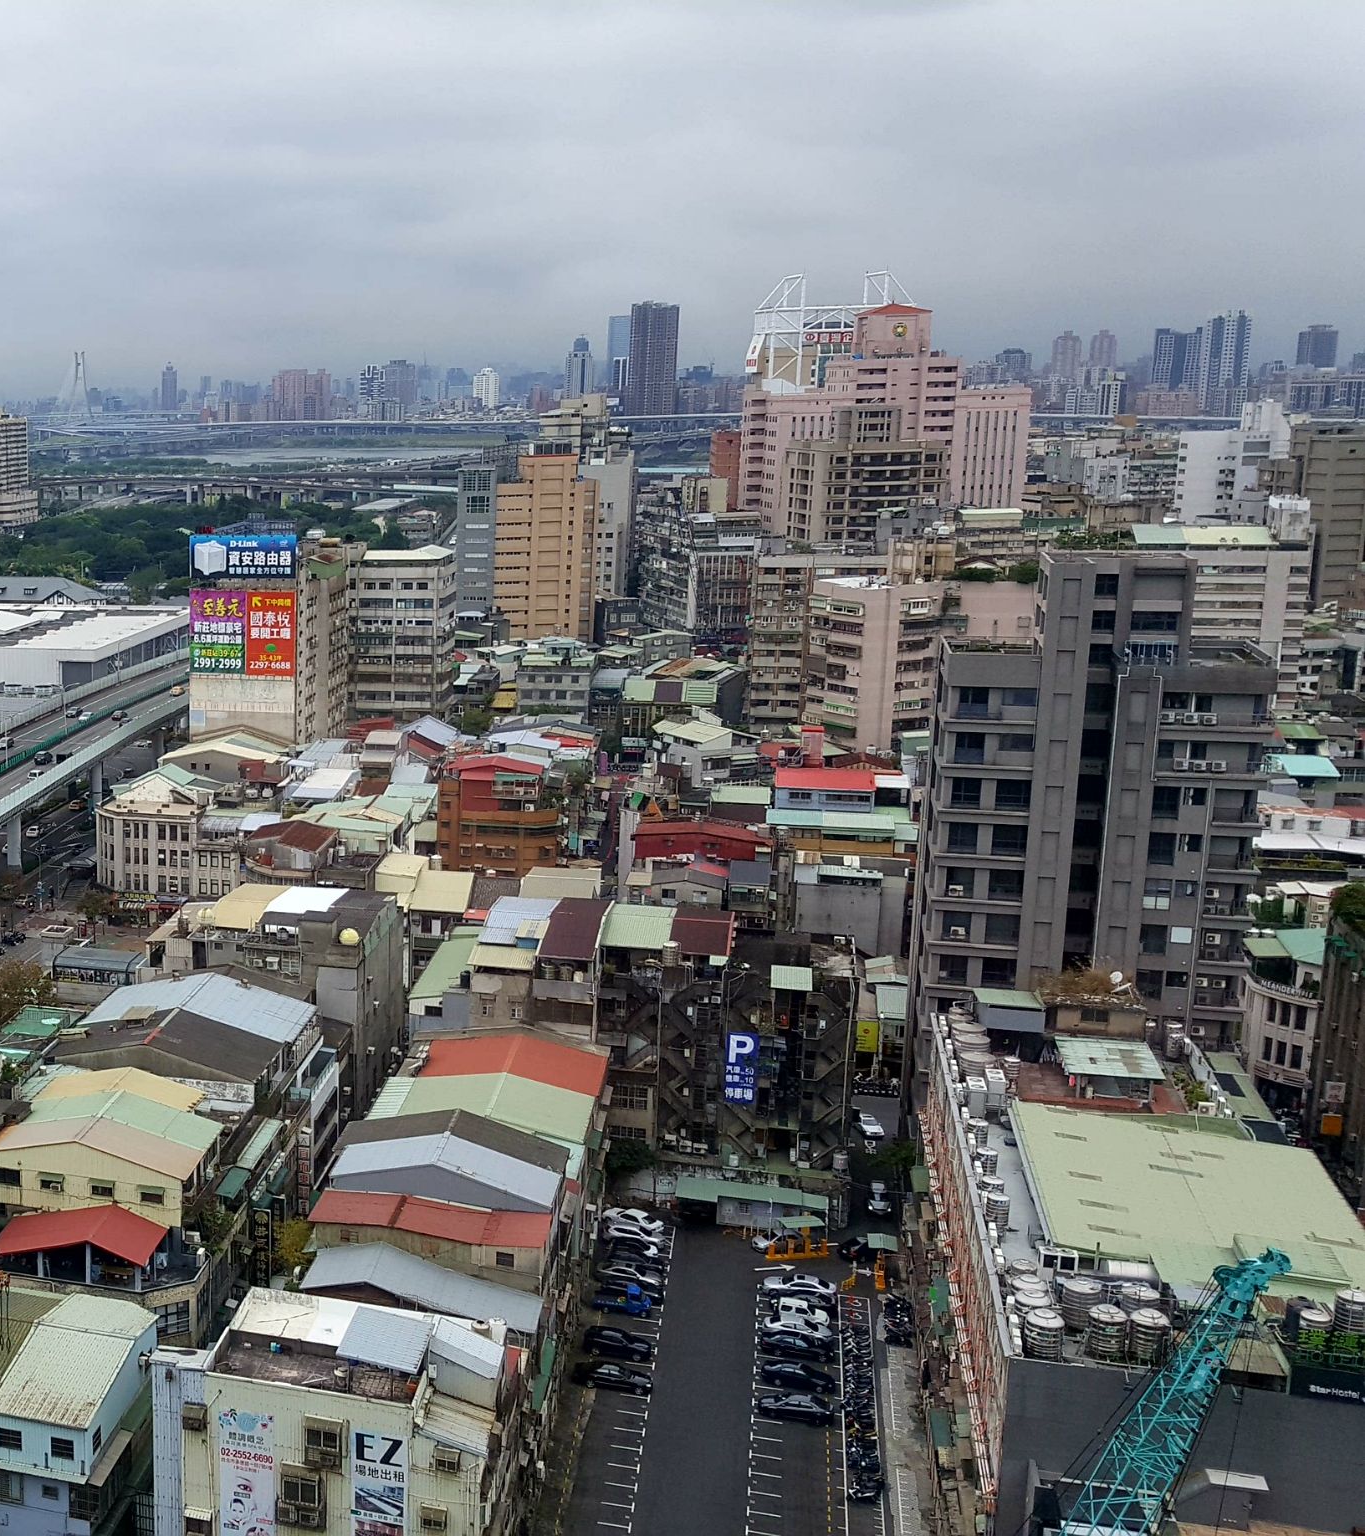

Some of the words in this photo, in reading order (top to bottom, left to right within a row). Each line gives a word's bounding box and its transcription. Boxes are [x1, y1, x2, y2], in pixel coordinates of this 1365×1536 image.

[230, 540, 258, 548] D-Link
[228, 551, 292, 566] 資安路由器
[203, 597, 243, 618] 至善元
[194, 657, 242, 669] 2991-2999
[250, 661, 291, 669] 2297-6688
[728, 1034, 754, 1063] P
[725, 1087, 753, 1101] 停車場
[1309, 1384, 1331, 1394] Star
[1331, 1388, 1360, 1399] Hostel
[220, 1447, 273, 1464] 02-2552-6690
[355, 1432, 404, 1467] EZ
[355, 1463, 404, 1483] 場地出租
